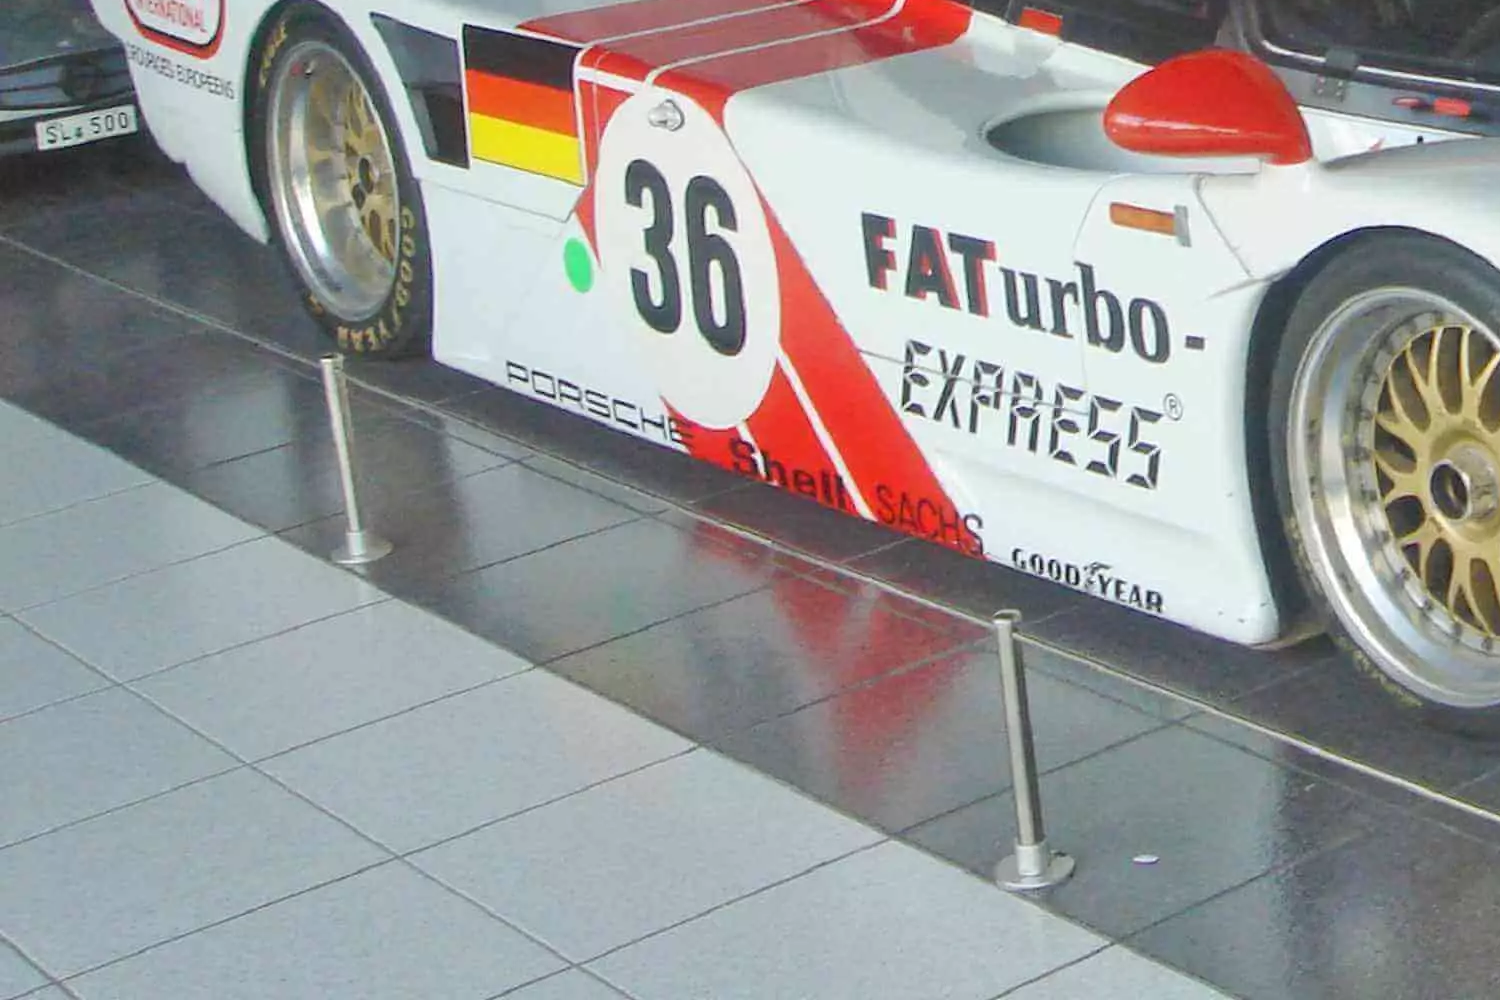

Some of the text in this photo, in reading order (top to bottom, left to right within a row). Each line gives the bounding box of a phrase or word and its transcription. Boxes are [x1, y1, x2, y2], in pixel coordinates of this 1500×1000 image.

[91, 112, 128, 134] 500
[624, 158, 746, 356] 36
[506, 361, 693, 443] PORSCHE
[729, 437, 851, 511] Shell
[877, 483, 984, 556] SACHS
